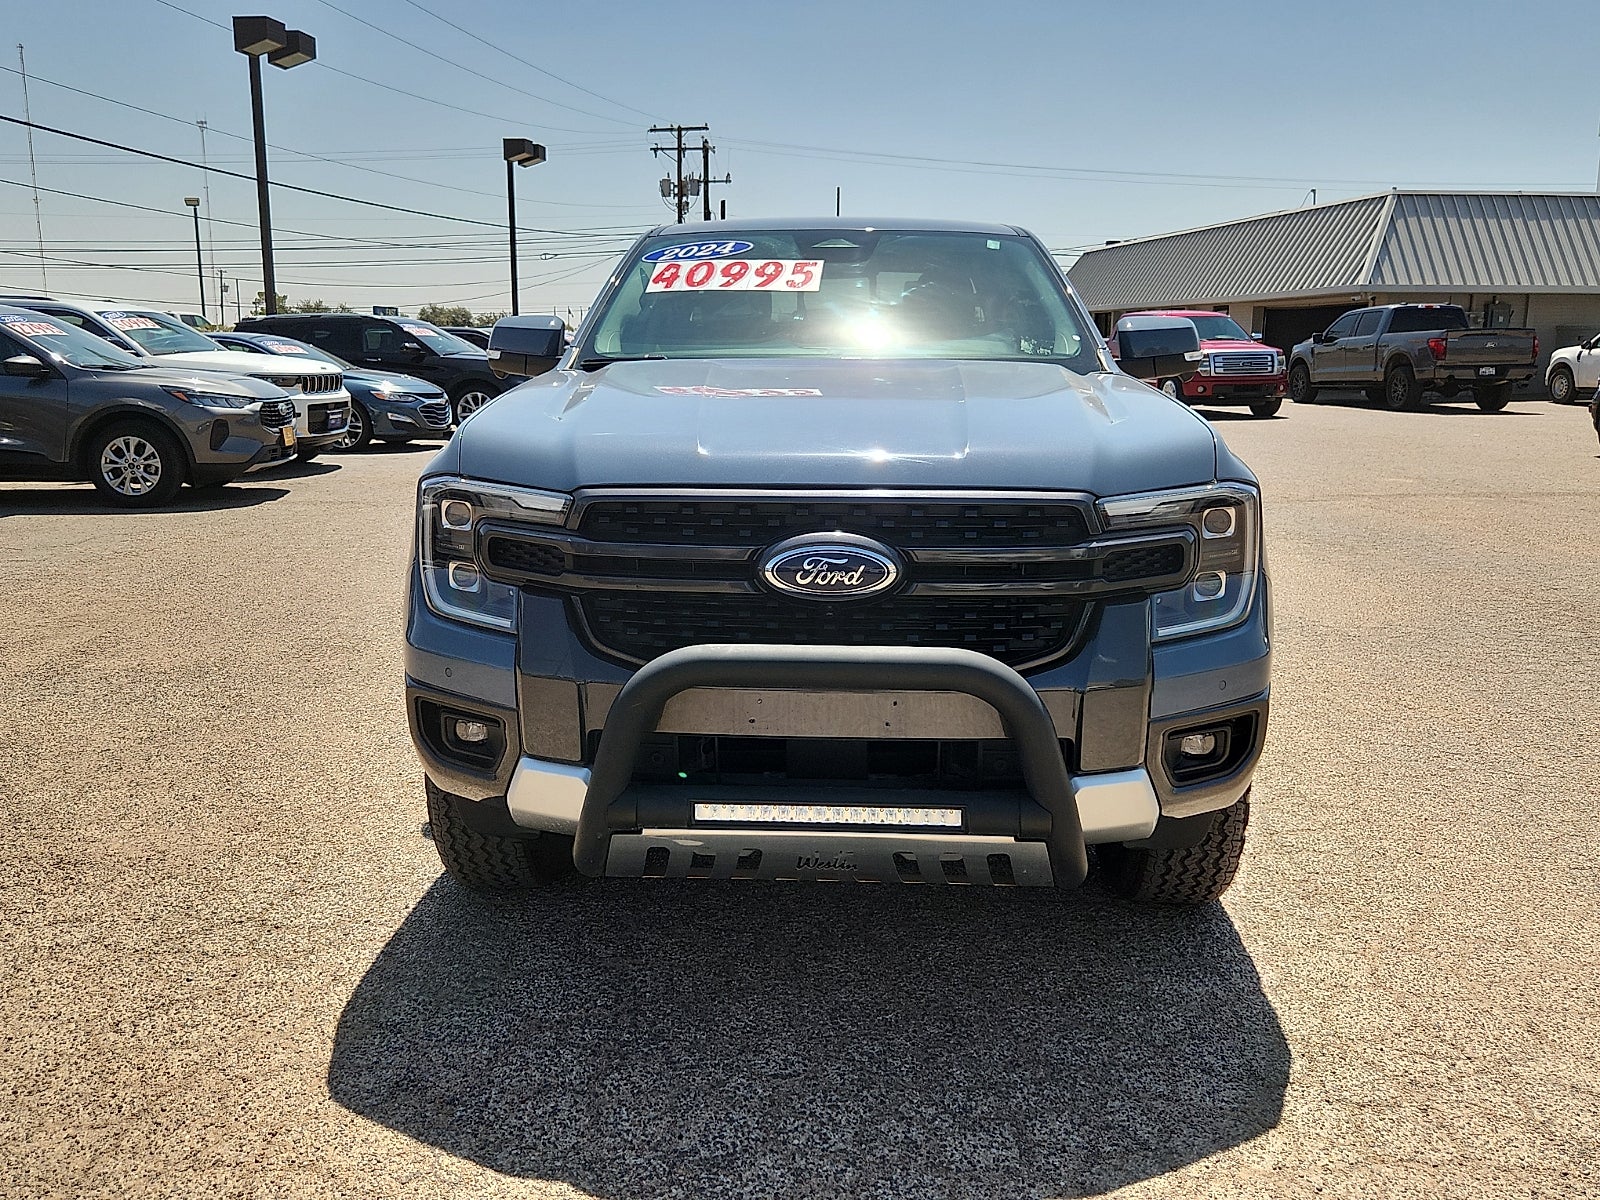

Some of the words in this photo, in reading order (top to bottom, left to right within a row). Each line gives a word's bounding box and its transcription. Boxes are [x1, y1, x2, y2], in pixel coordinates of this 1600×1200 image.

[658, 241, 735, 261] 2024
[652, 261, 818, 289] 40995
[795, 556, 865, 586] Ford
[795, 856, 858, 870] Westin
